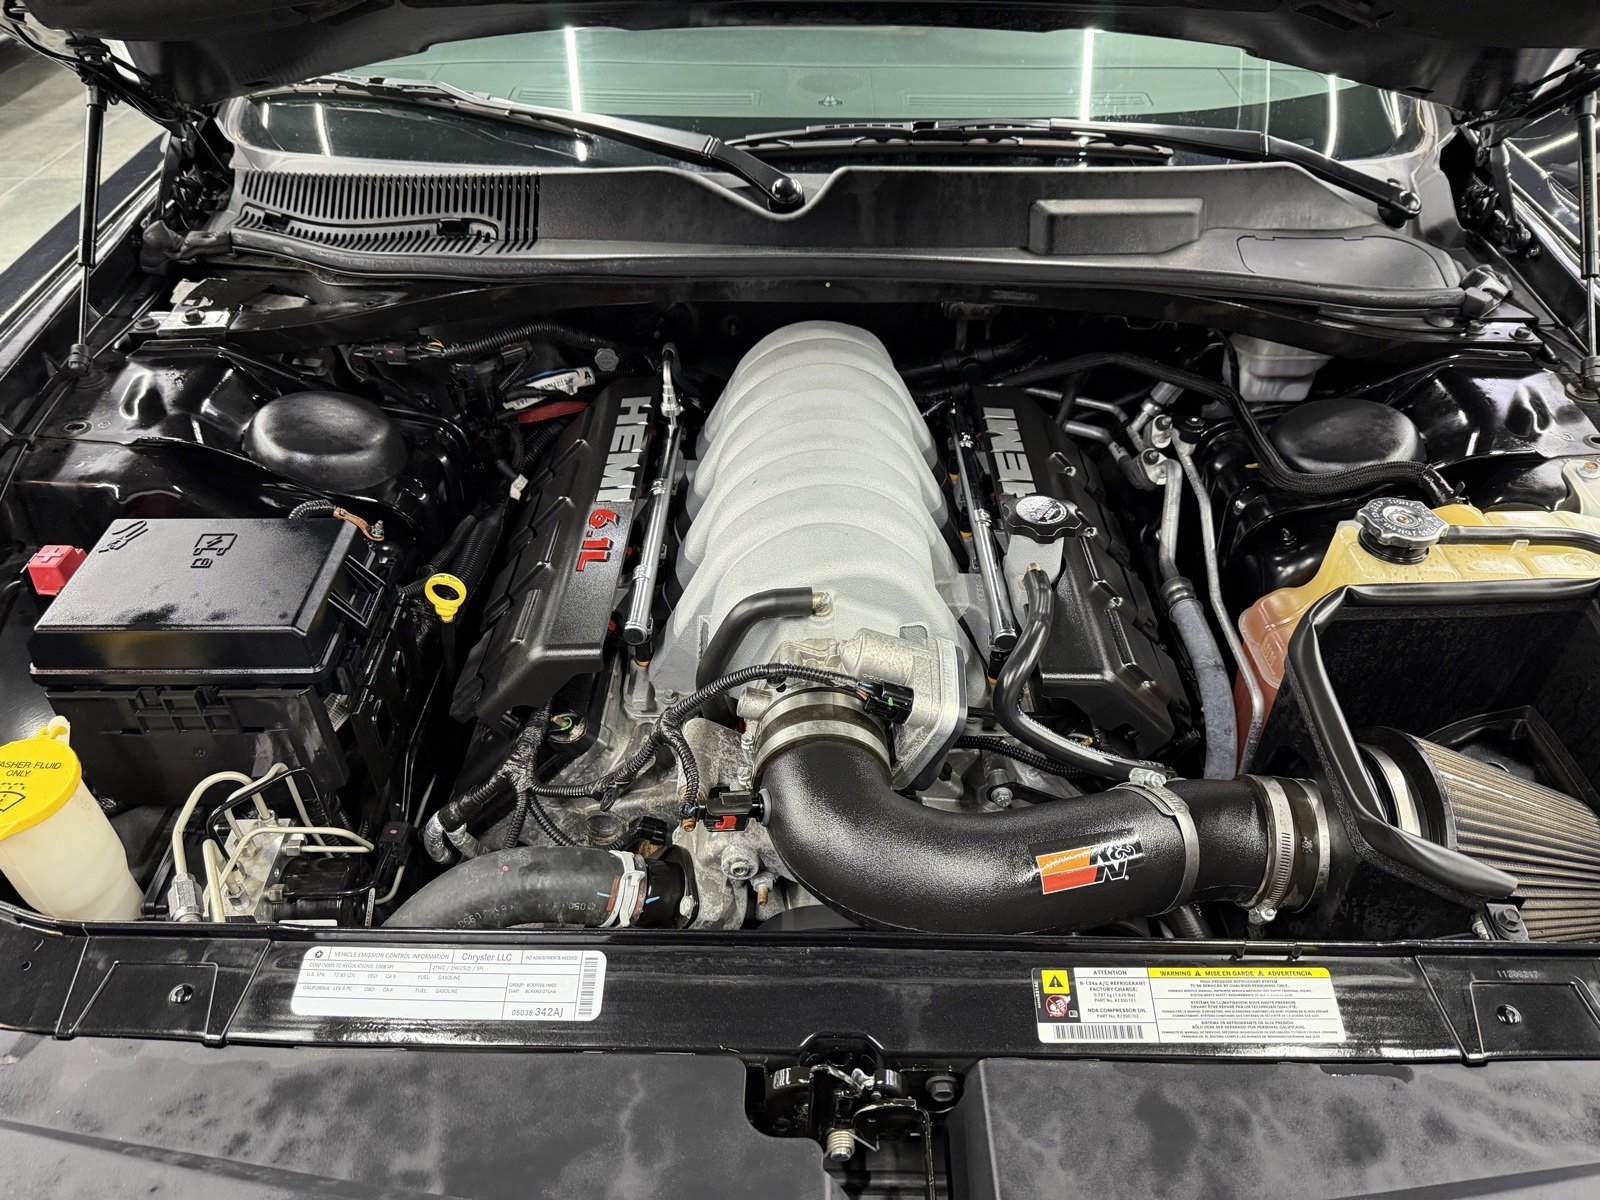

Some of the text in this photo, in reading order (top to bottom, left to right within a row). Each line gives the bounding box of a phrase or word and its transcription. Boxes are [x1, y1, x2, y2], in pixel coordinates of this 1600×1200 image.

[596, 396, 652, 502] HEMI
[576, 508, 620, 572] 6.1L
[462, 952, 512, 962] Chrysler LLC
[534, 1007, 564, 1017] 342AJ
